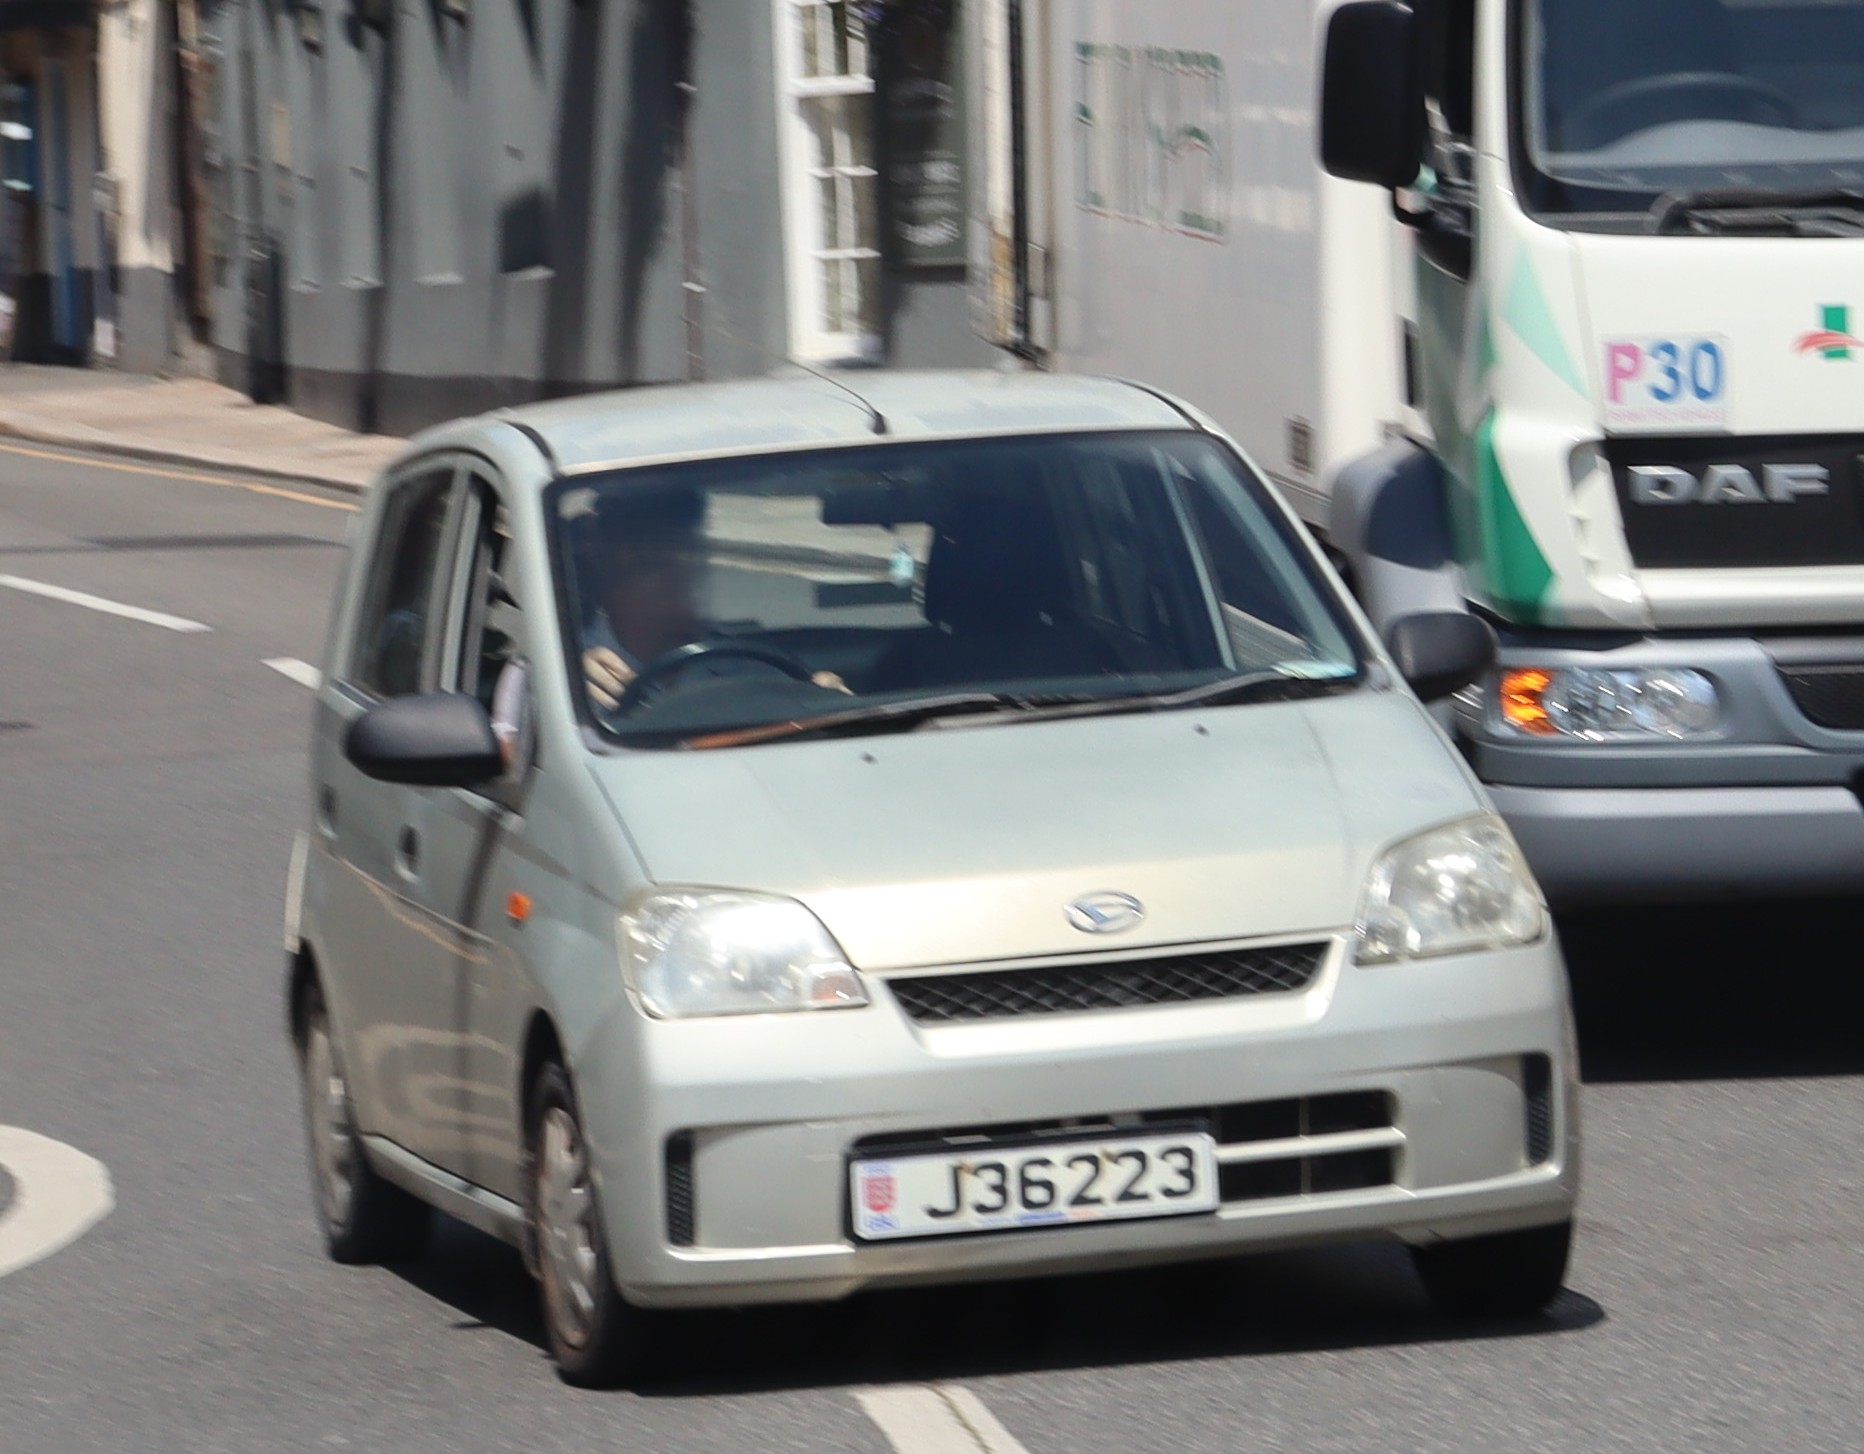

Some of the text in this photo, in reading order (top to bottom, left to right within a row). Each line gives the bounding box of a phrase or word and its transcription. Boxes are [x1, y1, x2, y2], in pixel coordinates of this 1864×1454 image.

[1608, 341, 1723, 402] P30
[1628, 464, 1830, 503] DAF
[924, 1147, 1196, 1217] J36223
